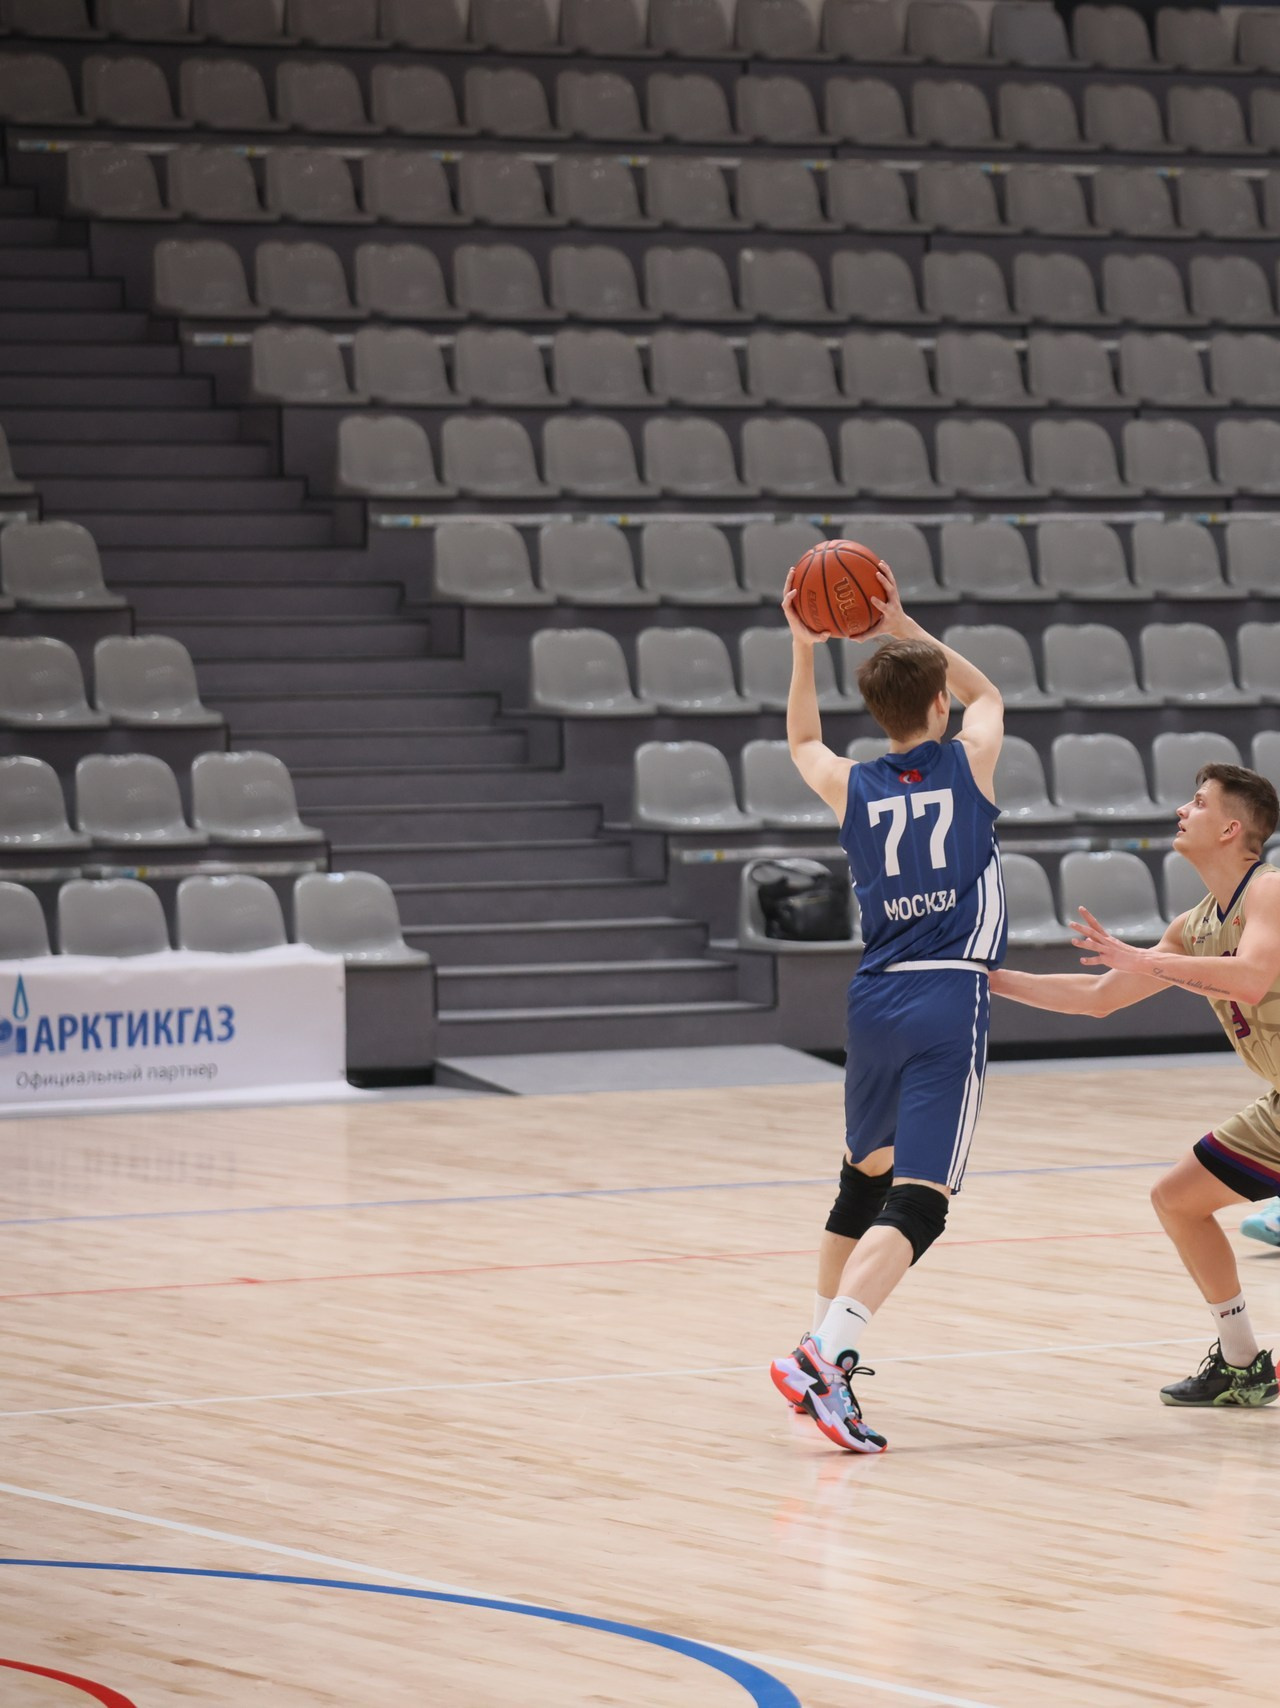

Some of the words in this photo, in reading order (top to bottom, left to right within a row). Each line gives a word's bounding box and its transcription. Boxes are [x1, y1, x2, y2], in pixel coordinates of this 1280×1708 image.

[867, 788, 954, 877] 77
[33, 1004, 236, 1053] АРКТИКГАЗ
[16, 1065, 142, 1089] Официальный
[147, 1062, 218, 1083] партнер
[1219, 1300, 1246, 1318] FIL
